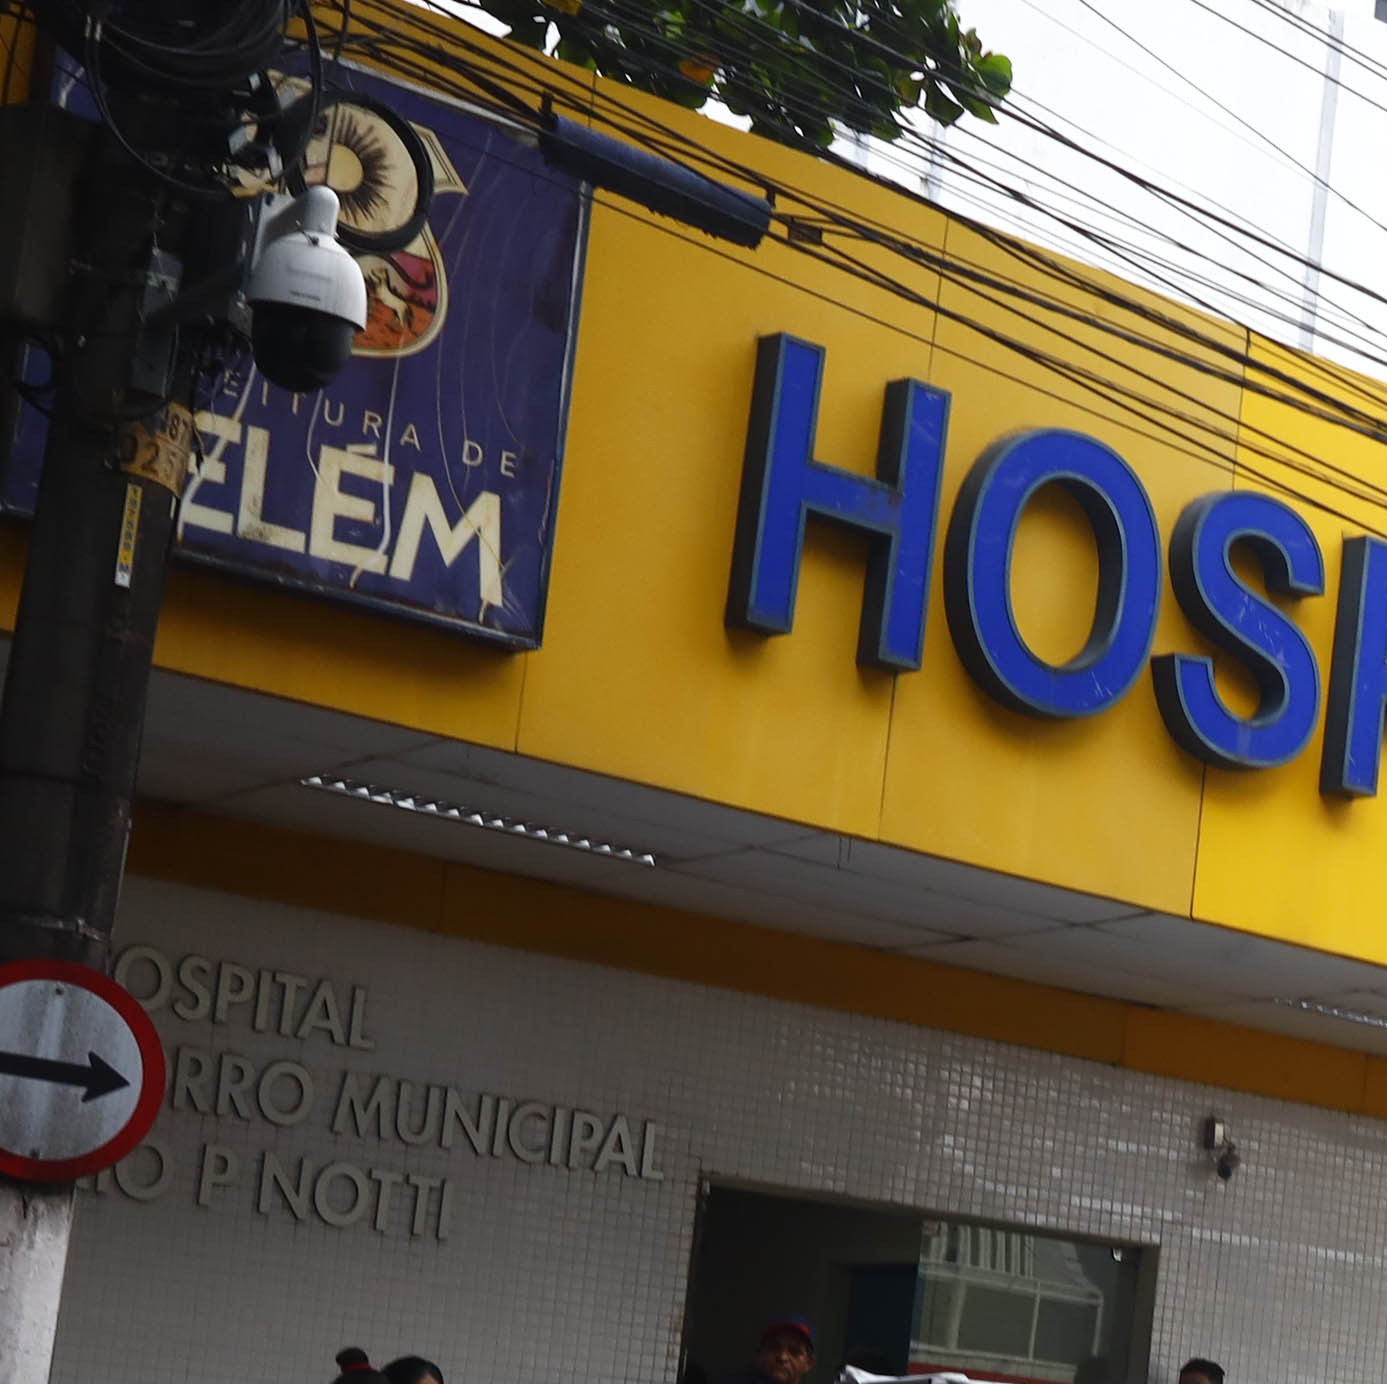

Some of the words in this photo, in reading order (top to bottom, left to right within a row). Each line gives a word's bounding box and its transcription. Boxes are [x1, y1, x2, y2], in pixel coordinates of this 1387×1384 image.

[223, 369, 421, 450] EITURA
[461, 439, 517, 479] DE
[178, 411, 503, 608] ELÉM
[114, 945, 376, 1049] OSPITAL
[172, 1046, 314, 1127] RRO
[331, 1070, 664, 1182] MUNICIPAL
